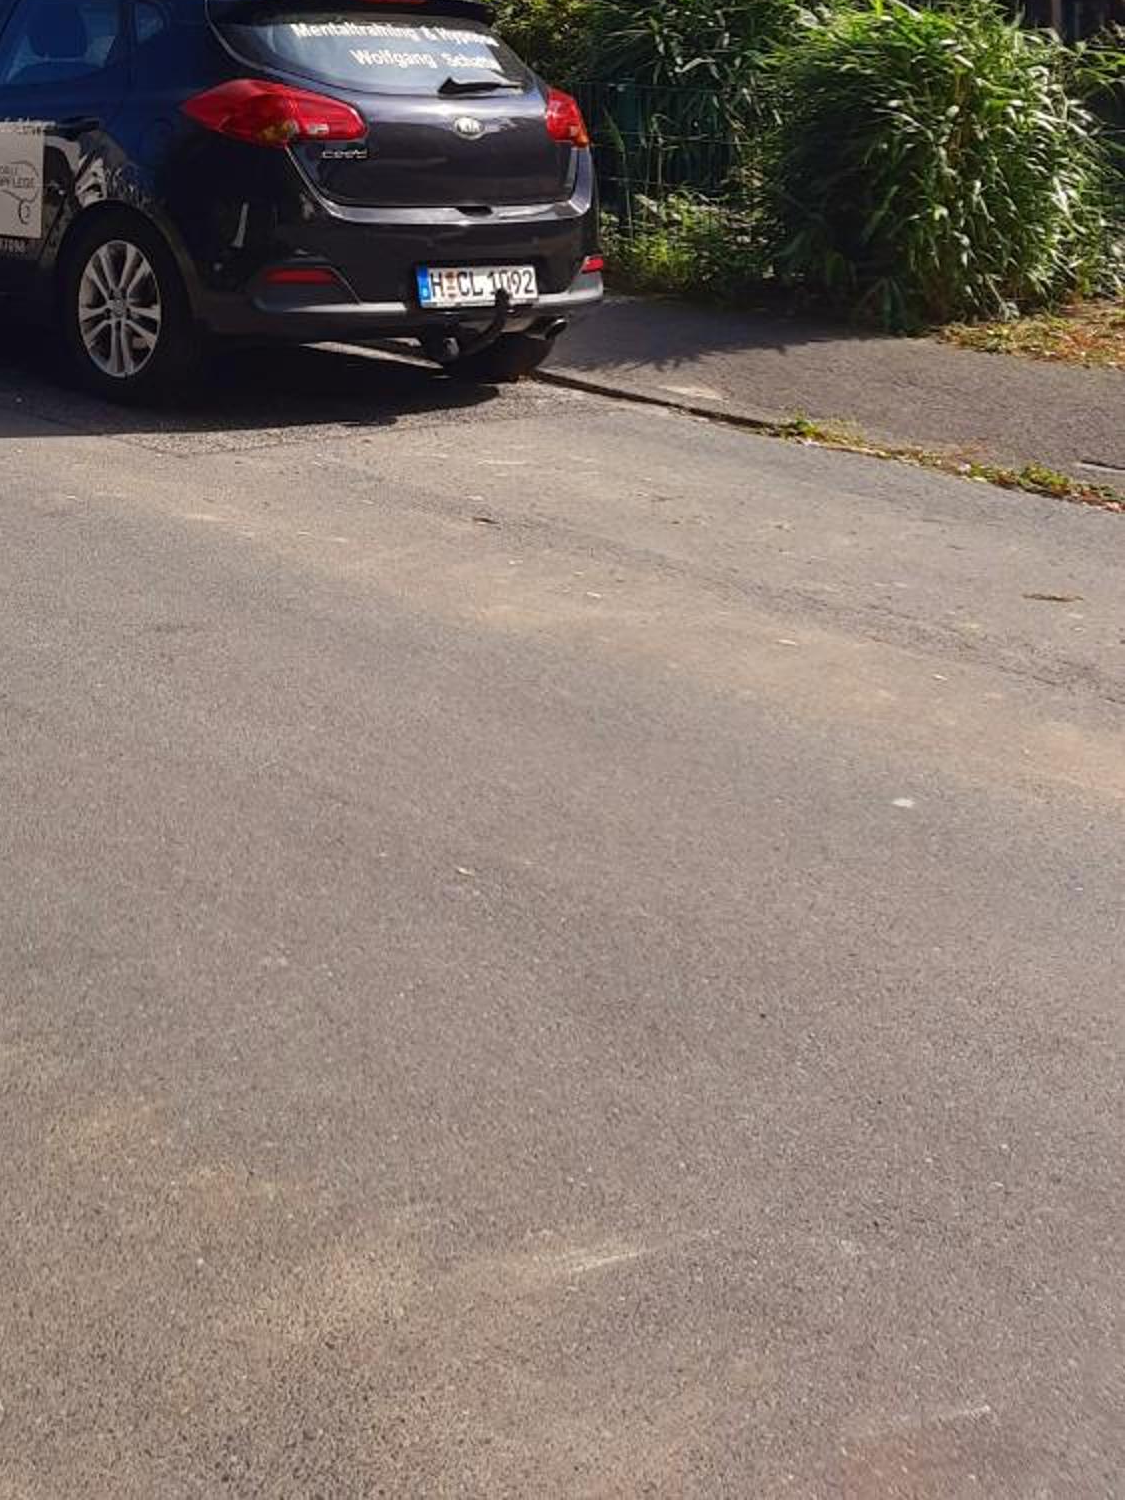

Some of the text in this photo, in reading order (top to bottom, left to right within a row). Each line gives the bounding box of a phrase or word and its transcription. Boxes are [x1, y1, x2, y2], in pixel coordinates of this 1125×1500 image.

[350, 50, 437, 68] Wolfgang
[431, 271, 444, 297] H
[456, 270, 483, 296] CL
